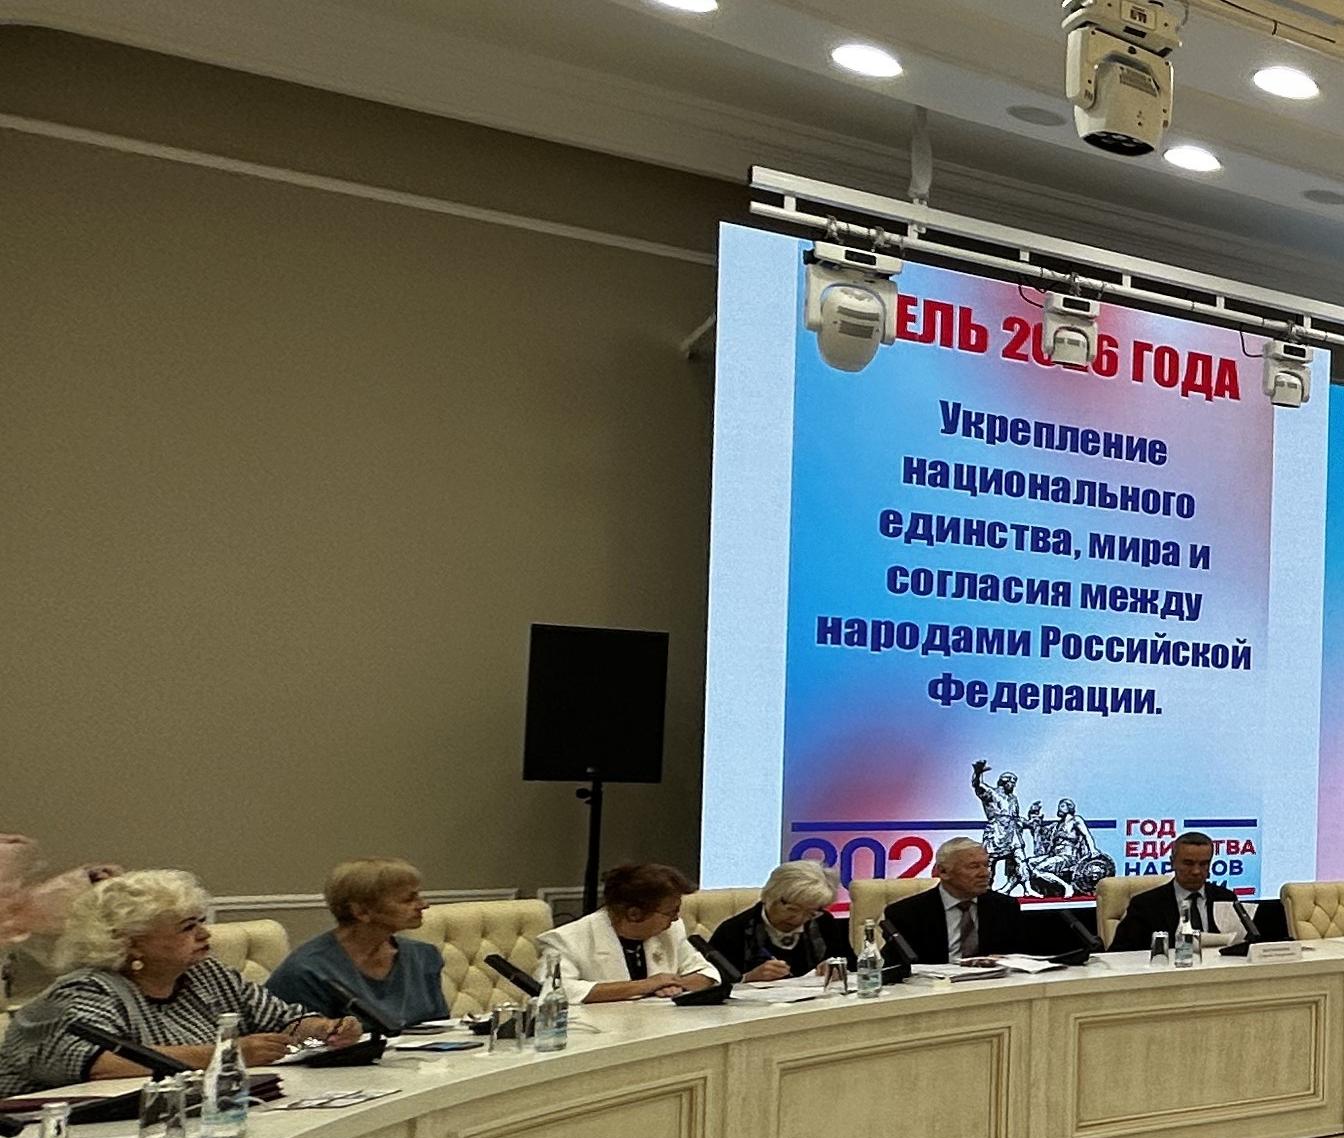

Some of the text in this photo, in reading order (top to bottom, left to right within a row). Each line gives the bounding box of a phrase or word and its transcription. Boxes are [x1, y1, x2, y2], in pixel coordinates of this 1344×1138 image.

[896, 294, 988, 353] ЕЛЬ
[1132, 340, 1241, 402] ГОДА
[939, 400, 1168, 467] Укрепление
[902, 455, 1196, 519] национального
[878, 508, 1211, 570] единства, мира и
[886, 565, 1203, 622] согласия между
[816, 615, 1252, 670] народами Российской
[927, 672, 1163, 717] Федерации.
[1125, 839, 1257, 860] ЕДИТВА
[1126, 819, 1176, 838] ГОД
[1125, 859, 1243, 876] НАРОВ
